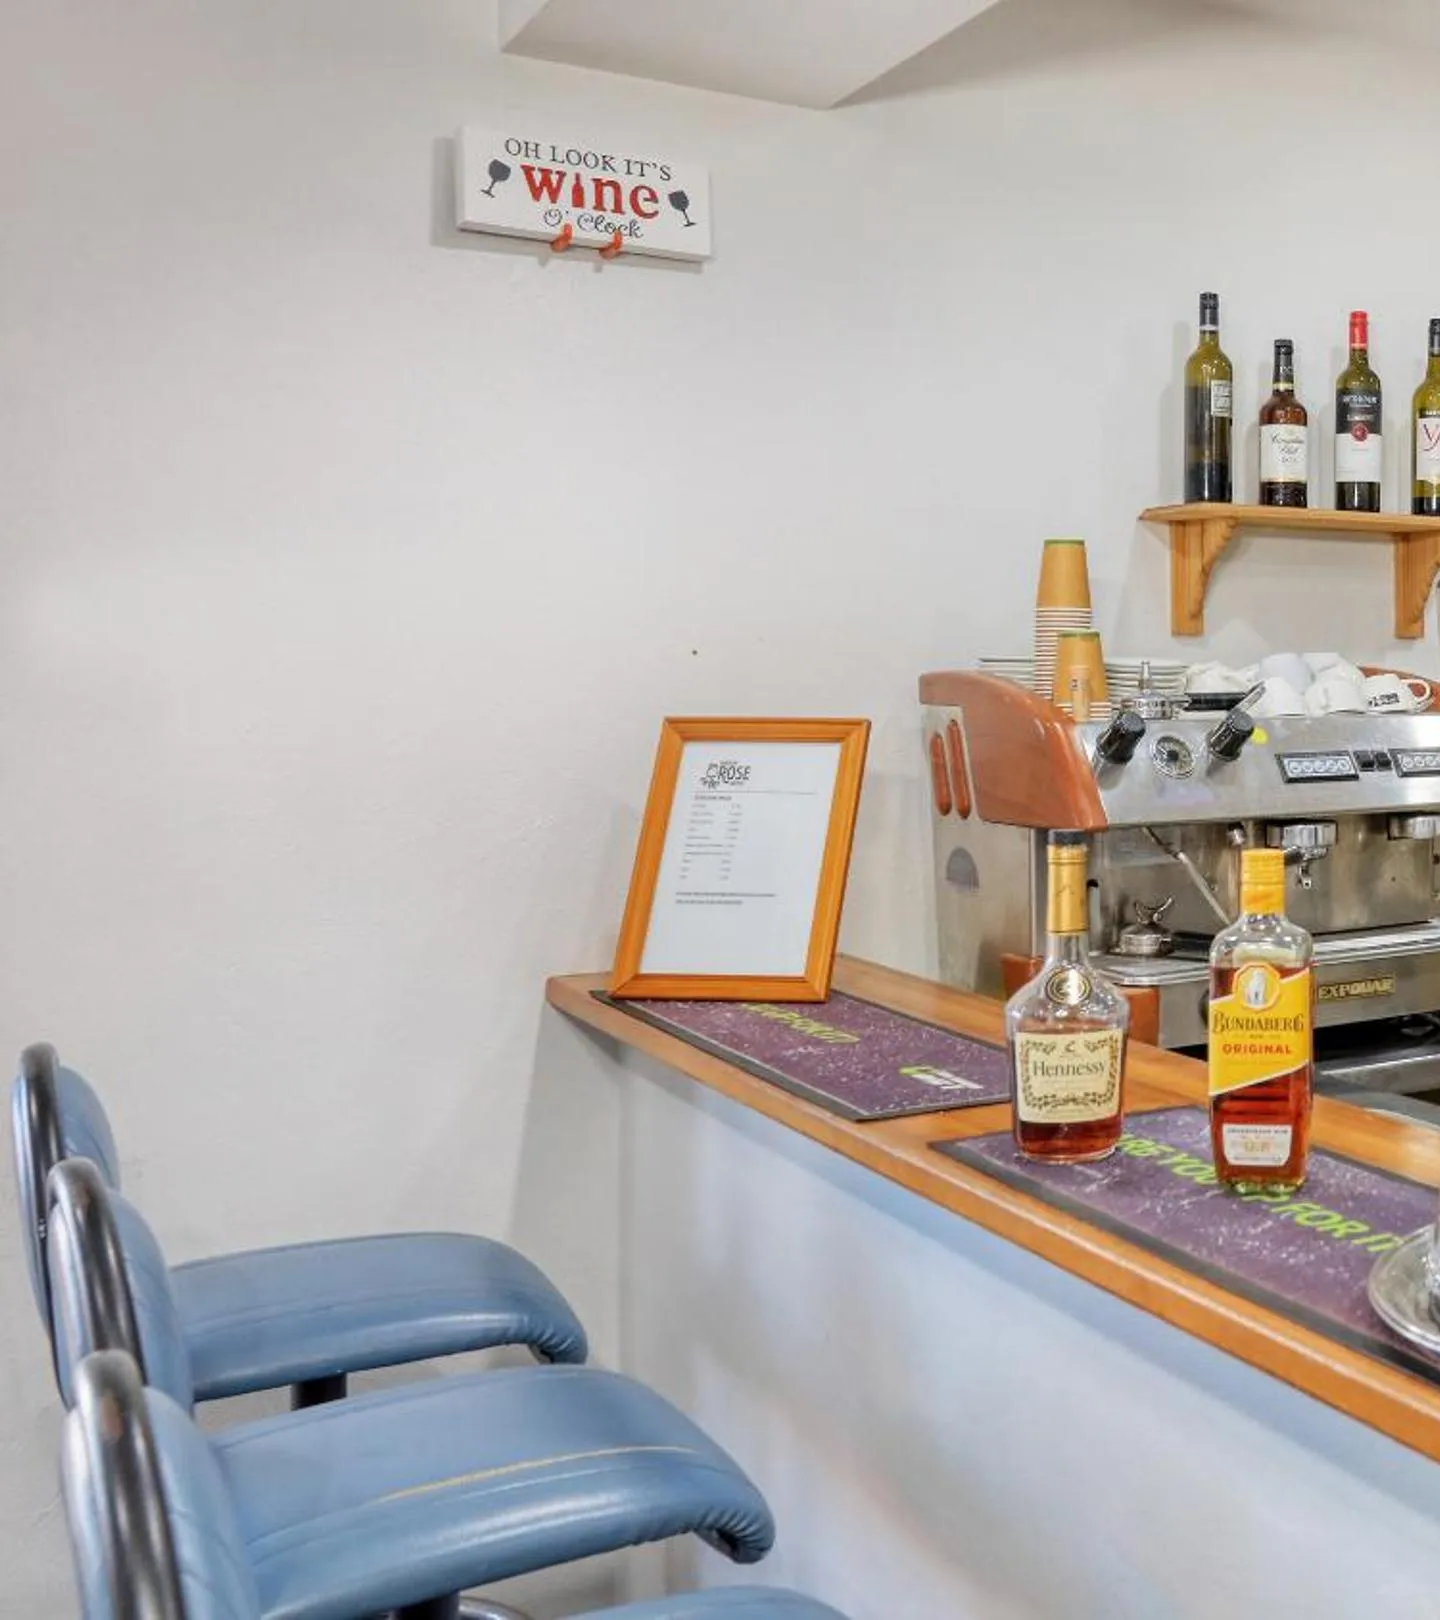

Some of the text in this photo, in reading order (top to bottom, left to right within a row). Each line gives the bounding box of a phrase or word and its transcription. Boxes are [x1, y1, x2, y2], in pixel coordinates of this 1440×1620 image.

[505, 137, 672, 182] OH LOOK IT'S
[1213, 1010, 1304, 1034] BUNDABERG
[1222, 1043, 1291, 1055] ORIGINAL
[1033, 1060, 1104, 1078] Hennessy
[1270, 1202, 1369, 1238] FOR
